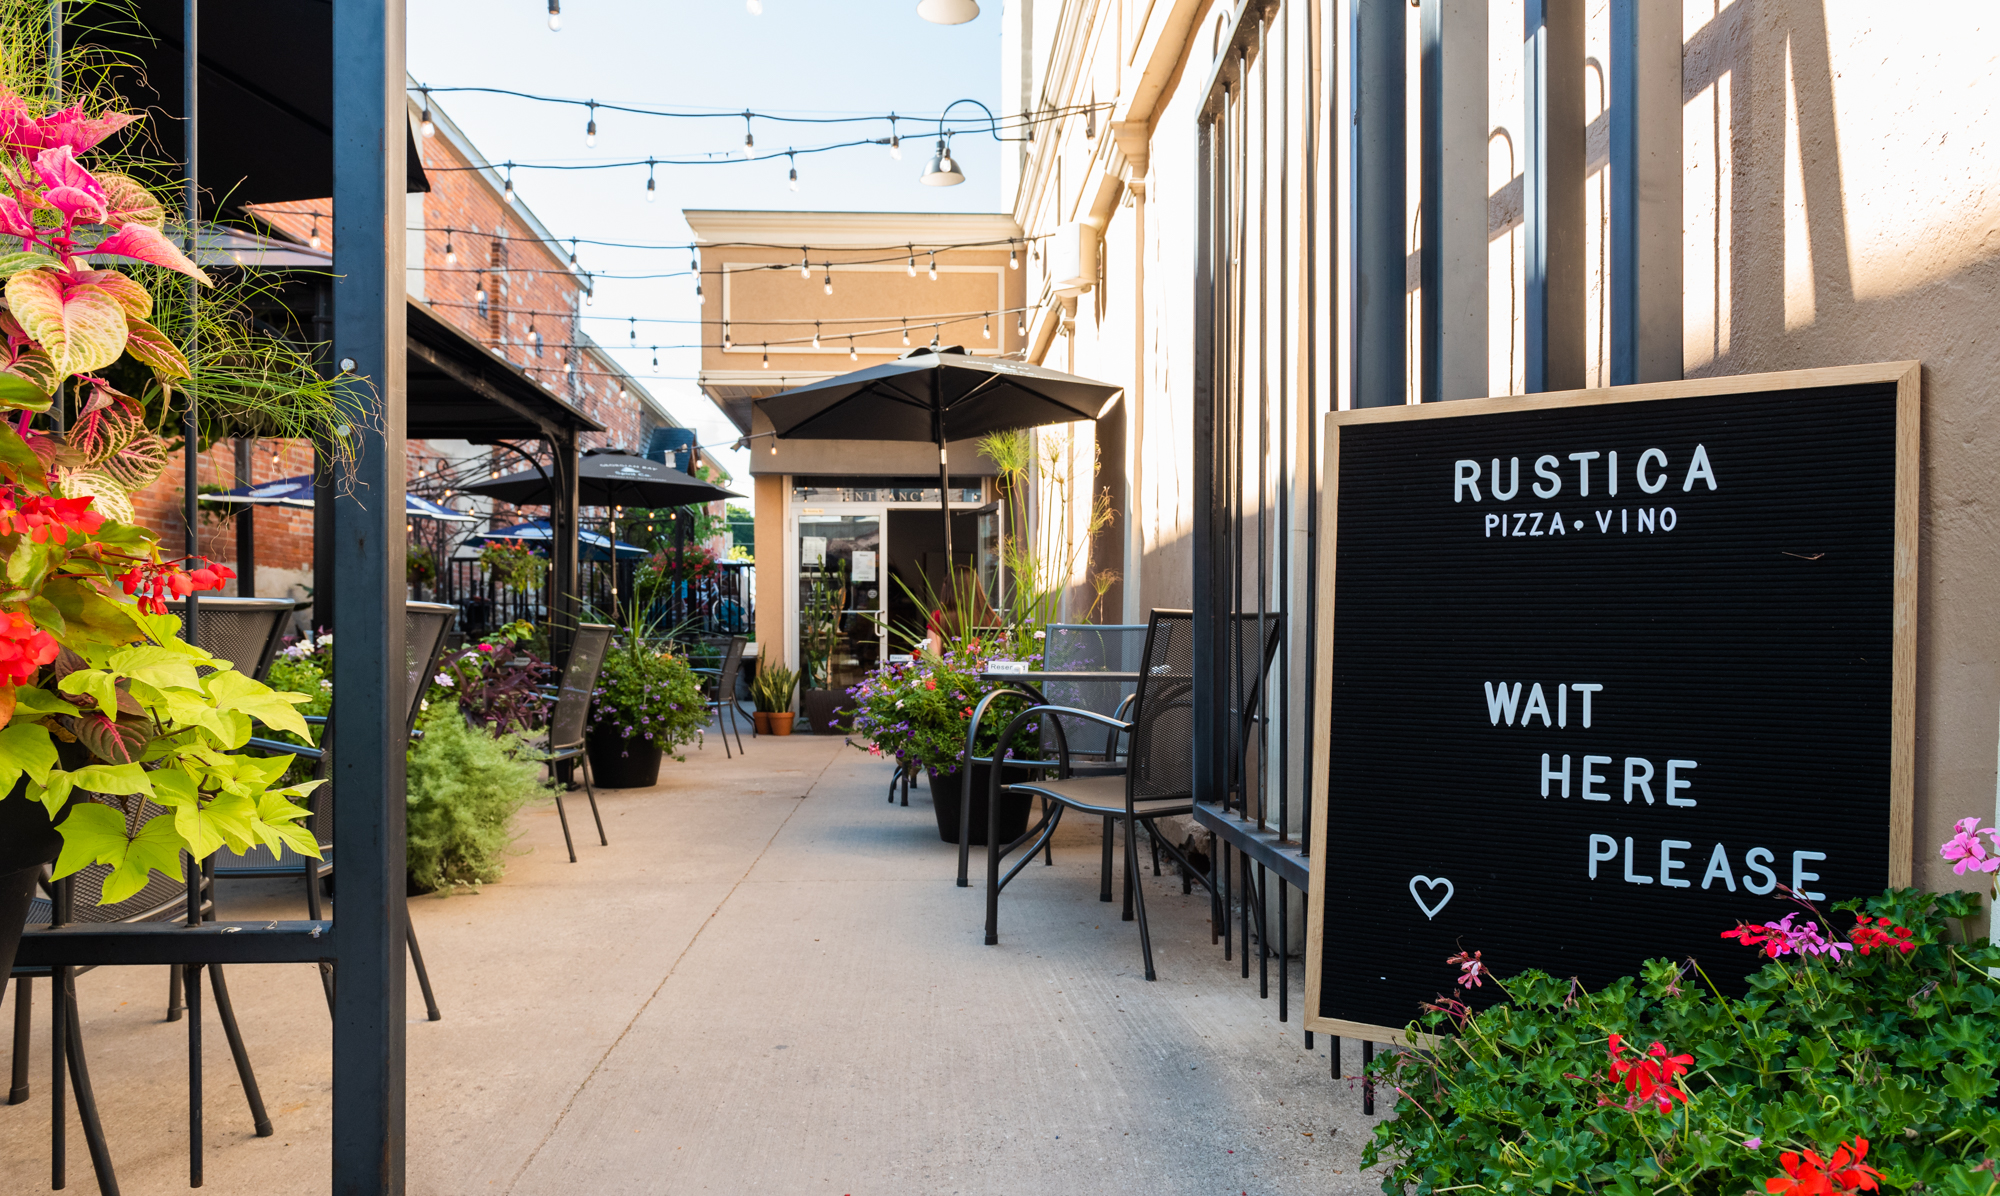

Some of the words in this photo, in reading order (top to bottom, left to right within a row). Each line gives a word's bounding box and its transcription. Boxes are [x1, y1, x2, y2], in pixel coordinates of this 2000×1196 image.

[842, 491, 927, 501] NTRANC
[1454, 443, 1718, 503] RUSTICA
[1485, 511, 1566, 538] PIZZA
[1595, 506, 1677, 535] VINO
[990, 663, 1026, 671] Reserd
[1484, 680, 1604, 730] WAIT
[1541, 752, 1698, 809] HERE
[1588, 833, 1827, 902] PLEASE
